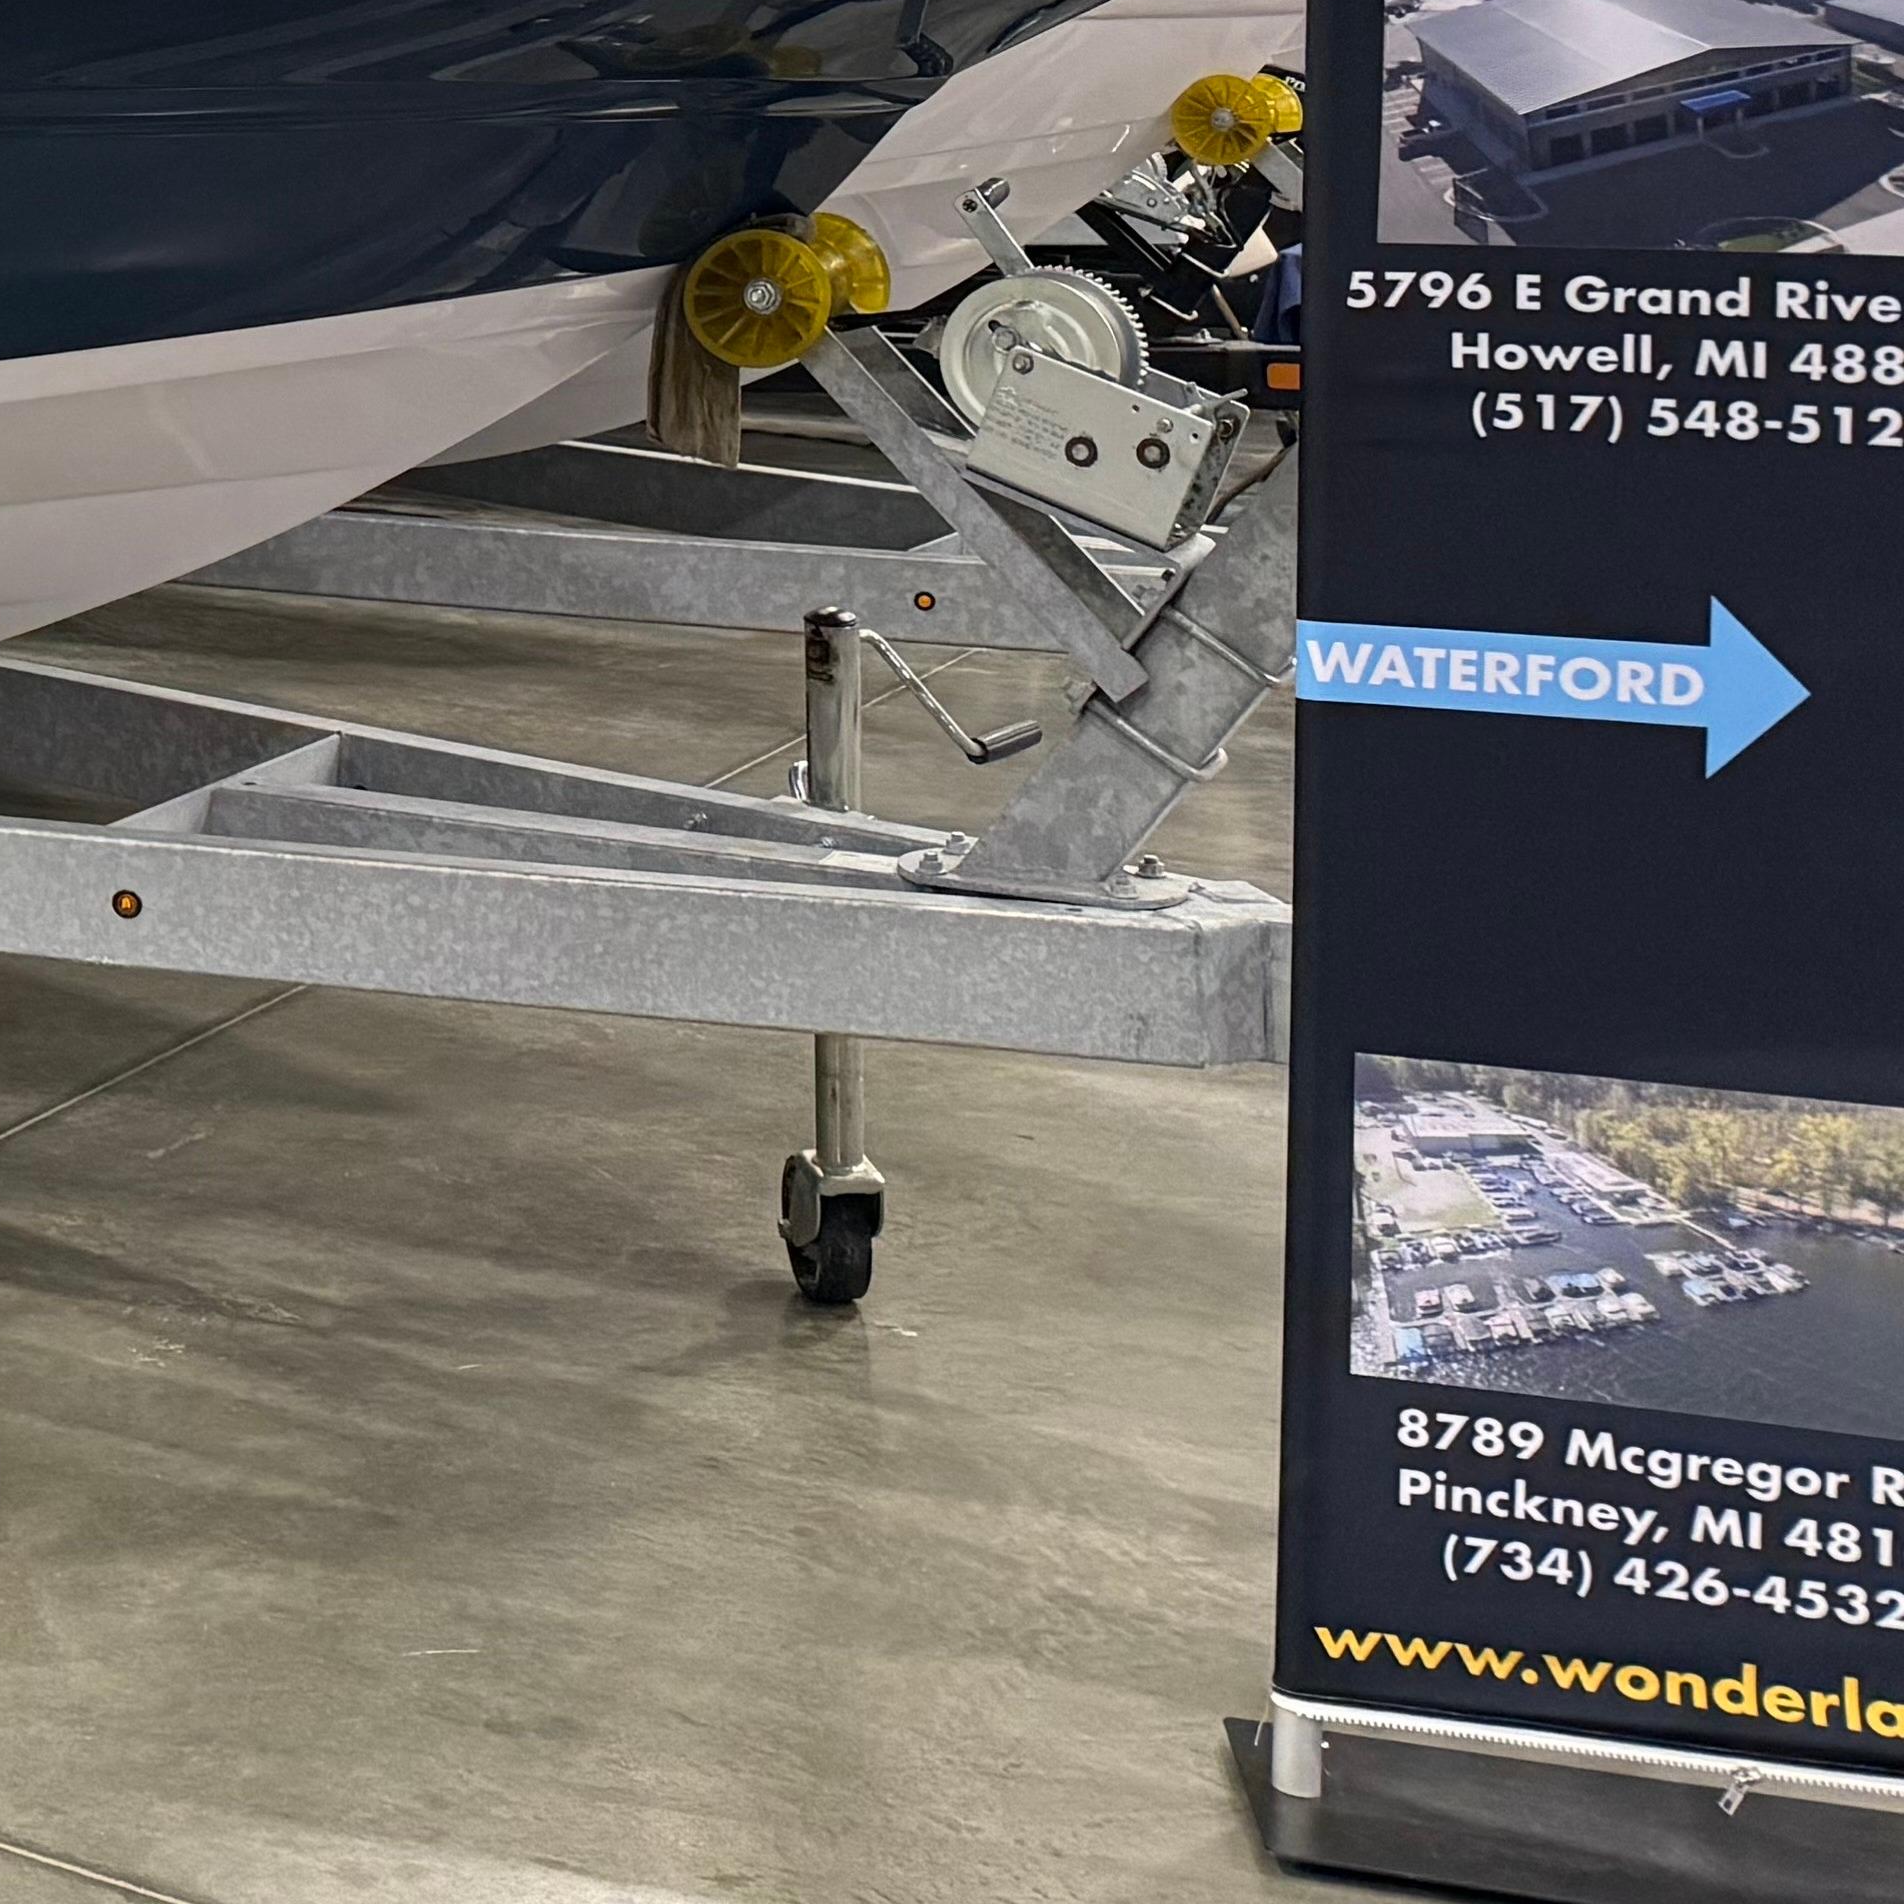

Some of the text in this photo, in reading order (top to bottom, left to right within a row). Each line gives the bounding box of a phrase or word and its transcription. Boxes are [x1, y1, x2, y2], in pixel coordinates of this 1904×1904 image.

[1345, 270, 1492, 311] 5796
[1515, 274, 1542, 310] E
[1564, 274, 1752, 318] Grand
[1451, 332, 1673, 381] Howell,
[1694, 340, 1767, 379] MI
[1472, 392, 1623, 443] (517)
[1305, 640, 1705, 707] WATERFORD
[1396, 1408, 1544, 1460] 8789
[1565, 1428, 1851, 1503] Mcgregor
[1398, 1469, 1669, 1545] Pinckney,
[1690, 1505, 1763, 1550] MI
[1443, 1533, 1904, 1632] (734) 426-4532
